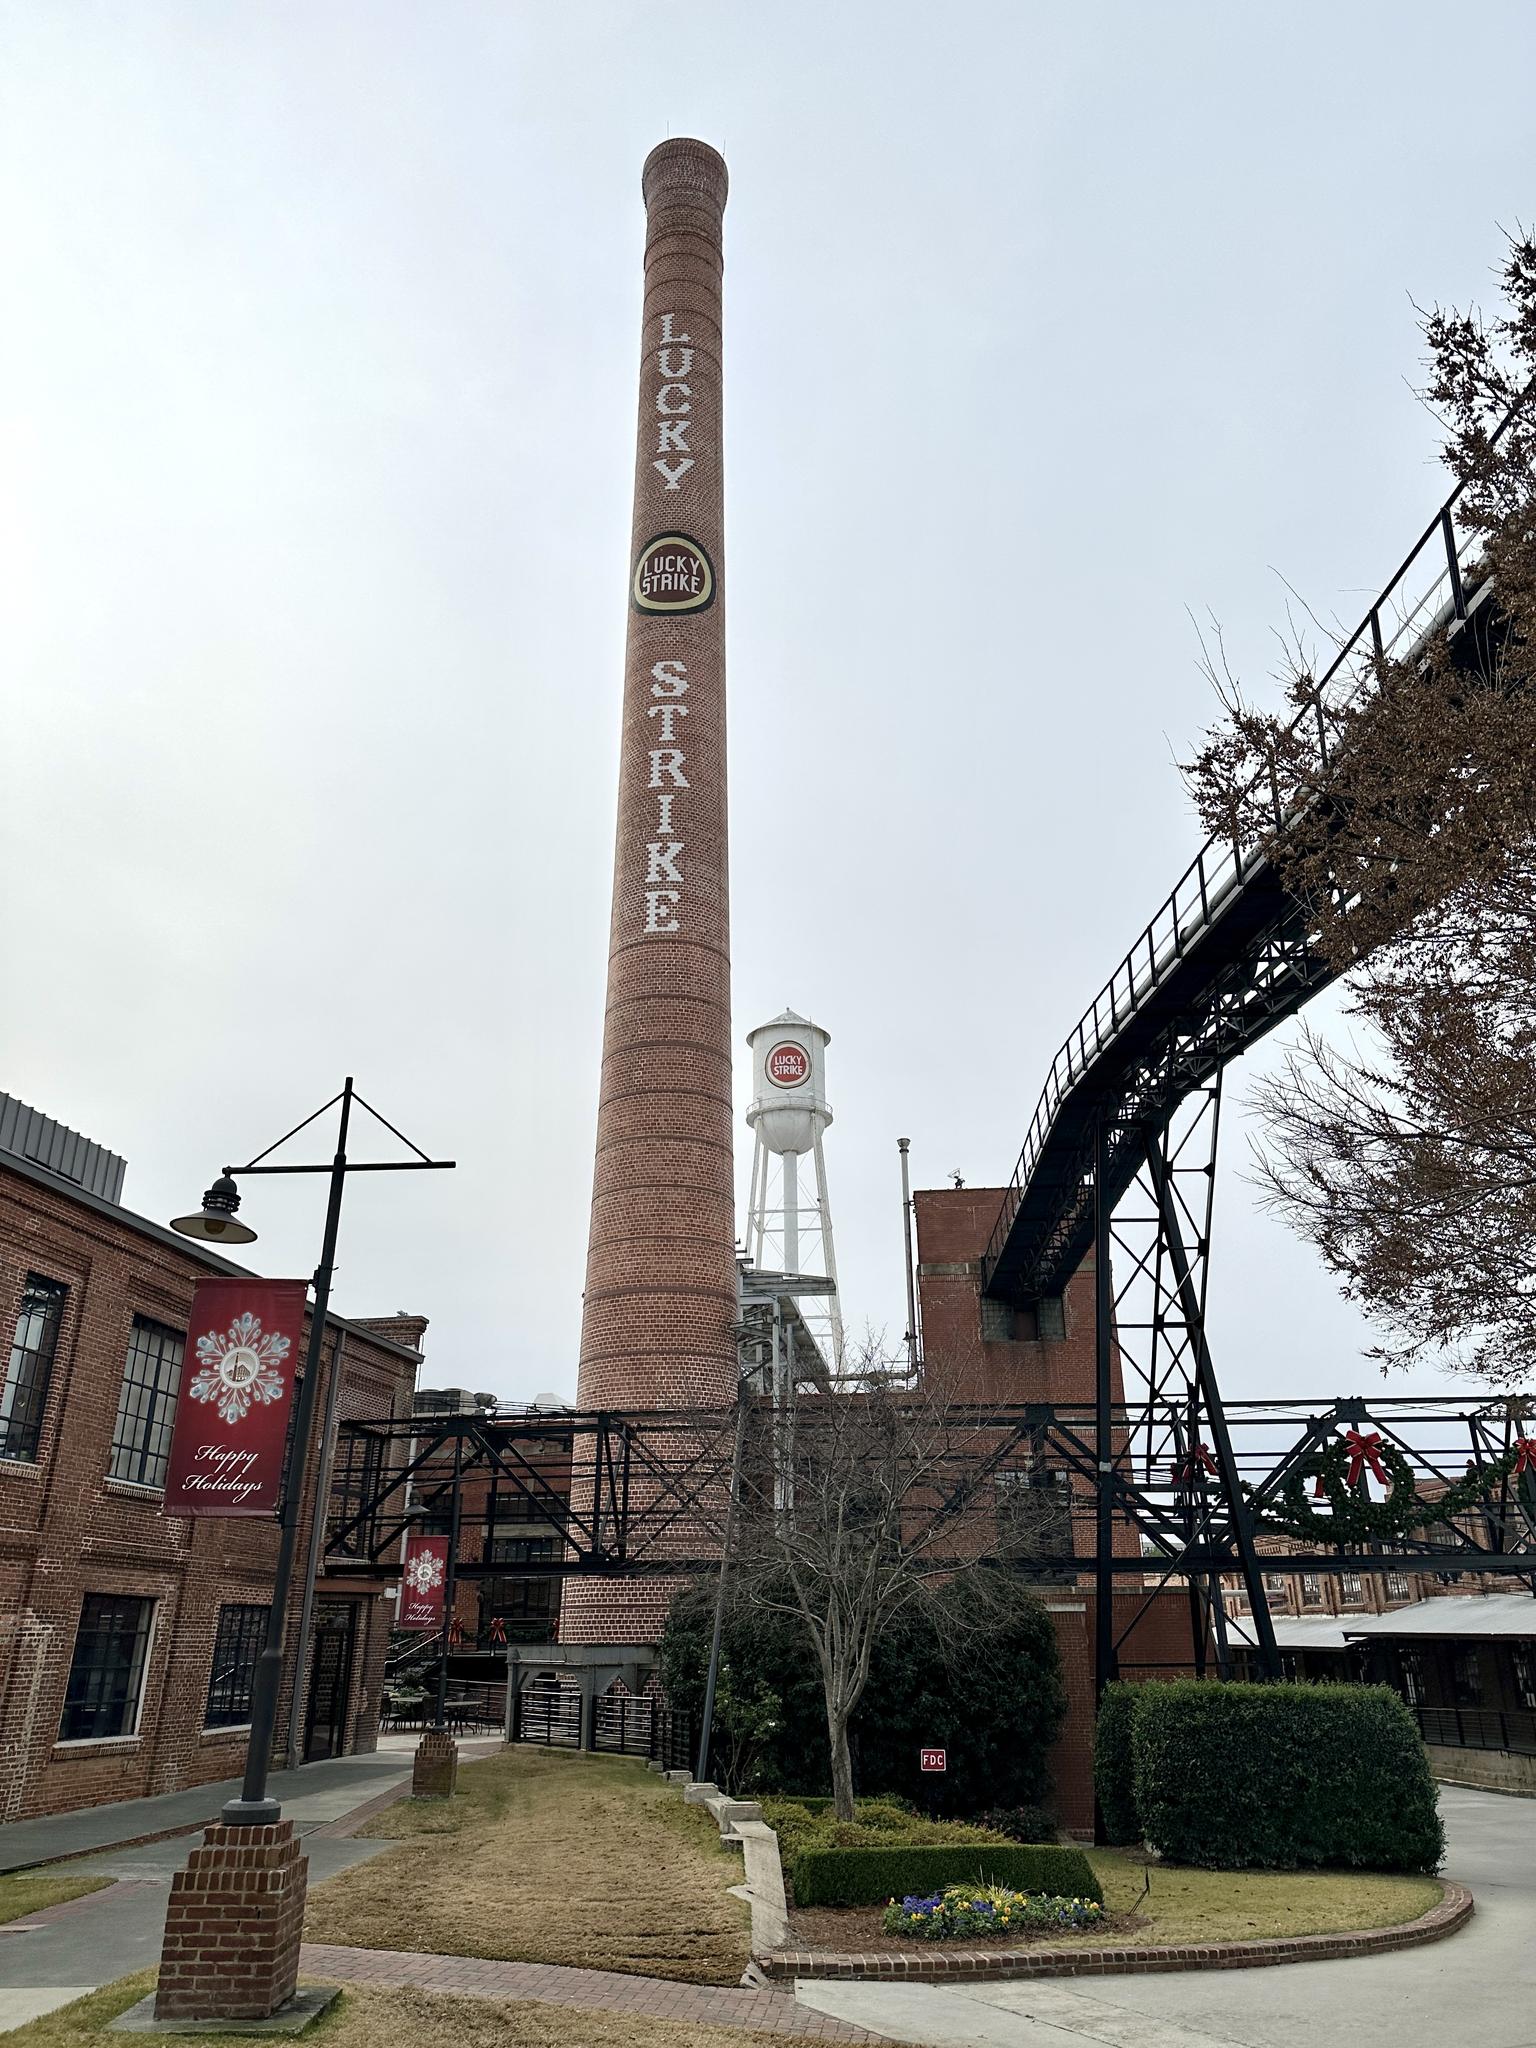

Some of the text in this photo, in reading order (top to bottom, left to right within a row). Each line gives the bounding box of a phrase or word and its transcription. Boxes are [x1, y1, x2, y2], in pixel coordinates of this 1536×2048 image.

[653, 313, 695, 490] LUCKY
[644, 555, 700, 577] LUCKY
[642, 573, 700, 596] STRIKE
[643, 660, 690, 932] STRIKE
[773, 1065, 803, 1076] STRIKE
[774, 1055, 802, 1066] LUCKY
[194, 1444, 259, 1473] Happy
[181, 1474, 264, 1503] Holidays
[408, 1602, 434, 1614] Happy
[404, 1613, 436, 1626] Holidays
[923, 1754, 944, 1766] FDC
